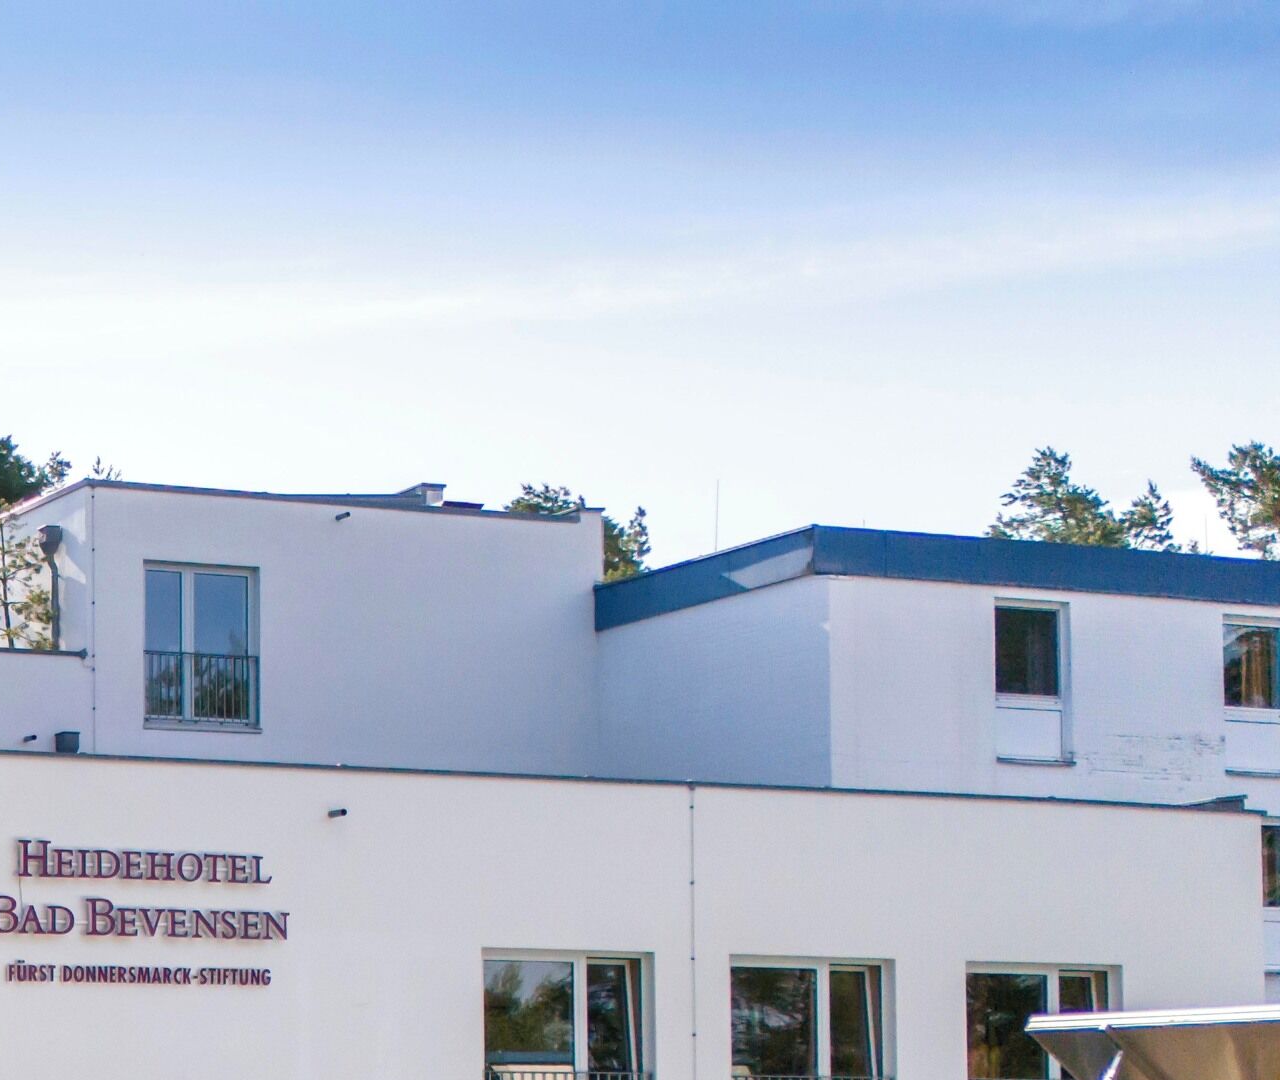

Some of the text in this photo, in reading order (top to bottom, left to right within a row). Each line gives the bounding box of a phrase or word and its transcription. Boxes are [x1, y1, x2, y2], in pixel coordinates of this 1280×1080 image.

[17, 839, 273, 884] HEIDEHOTEL
[85, 898, 291, 941] BEVENSEN
[7, 960, 272, 986] FÜRST DONNERSMARCK-STIFTUNG
